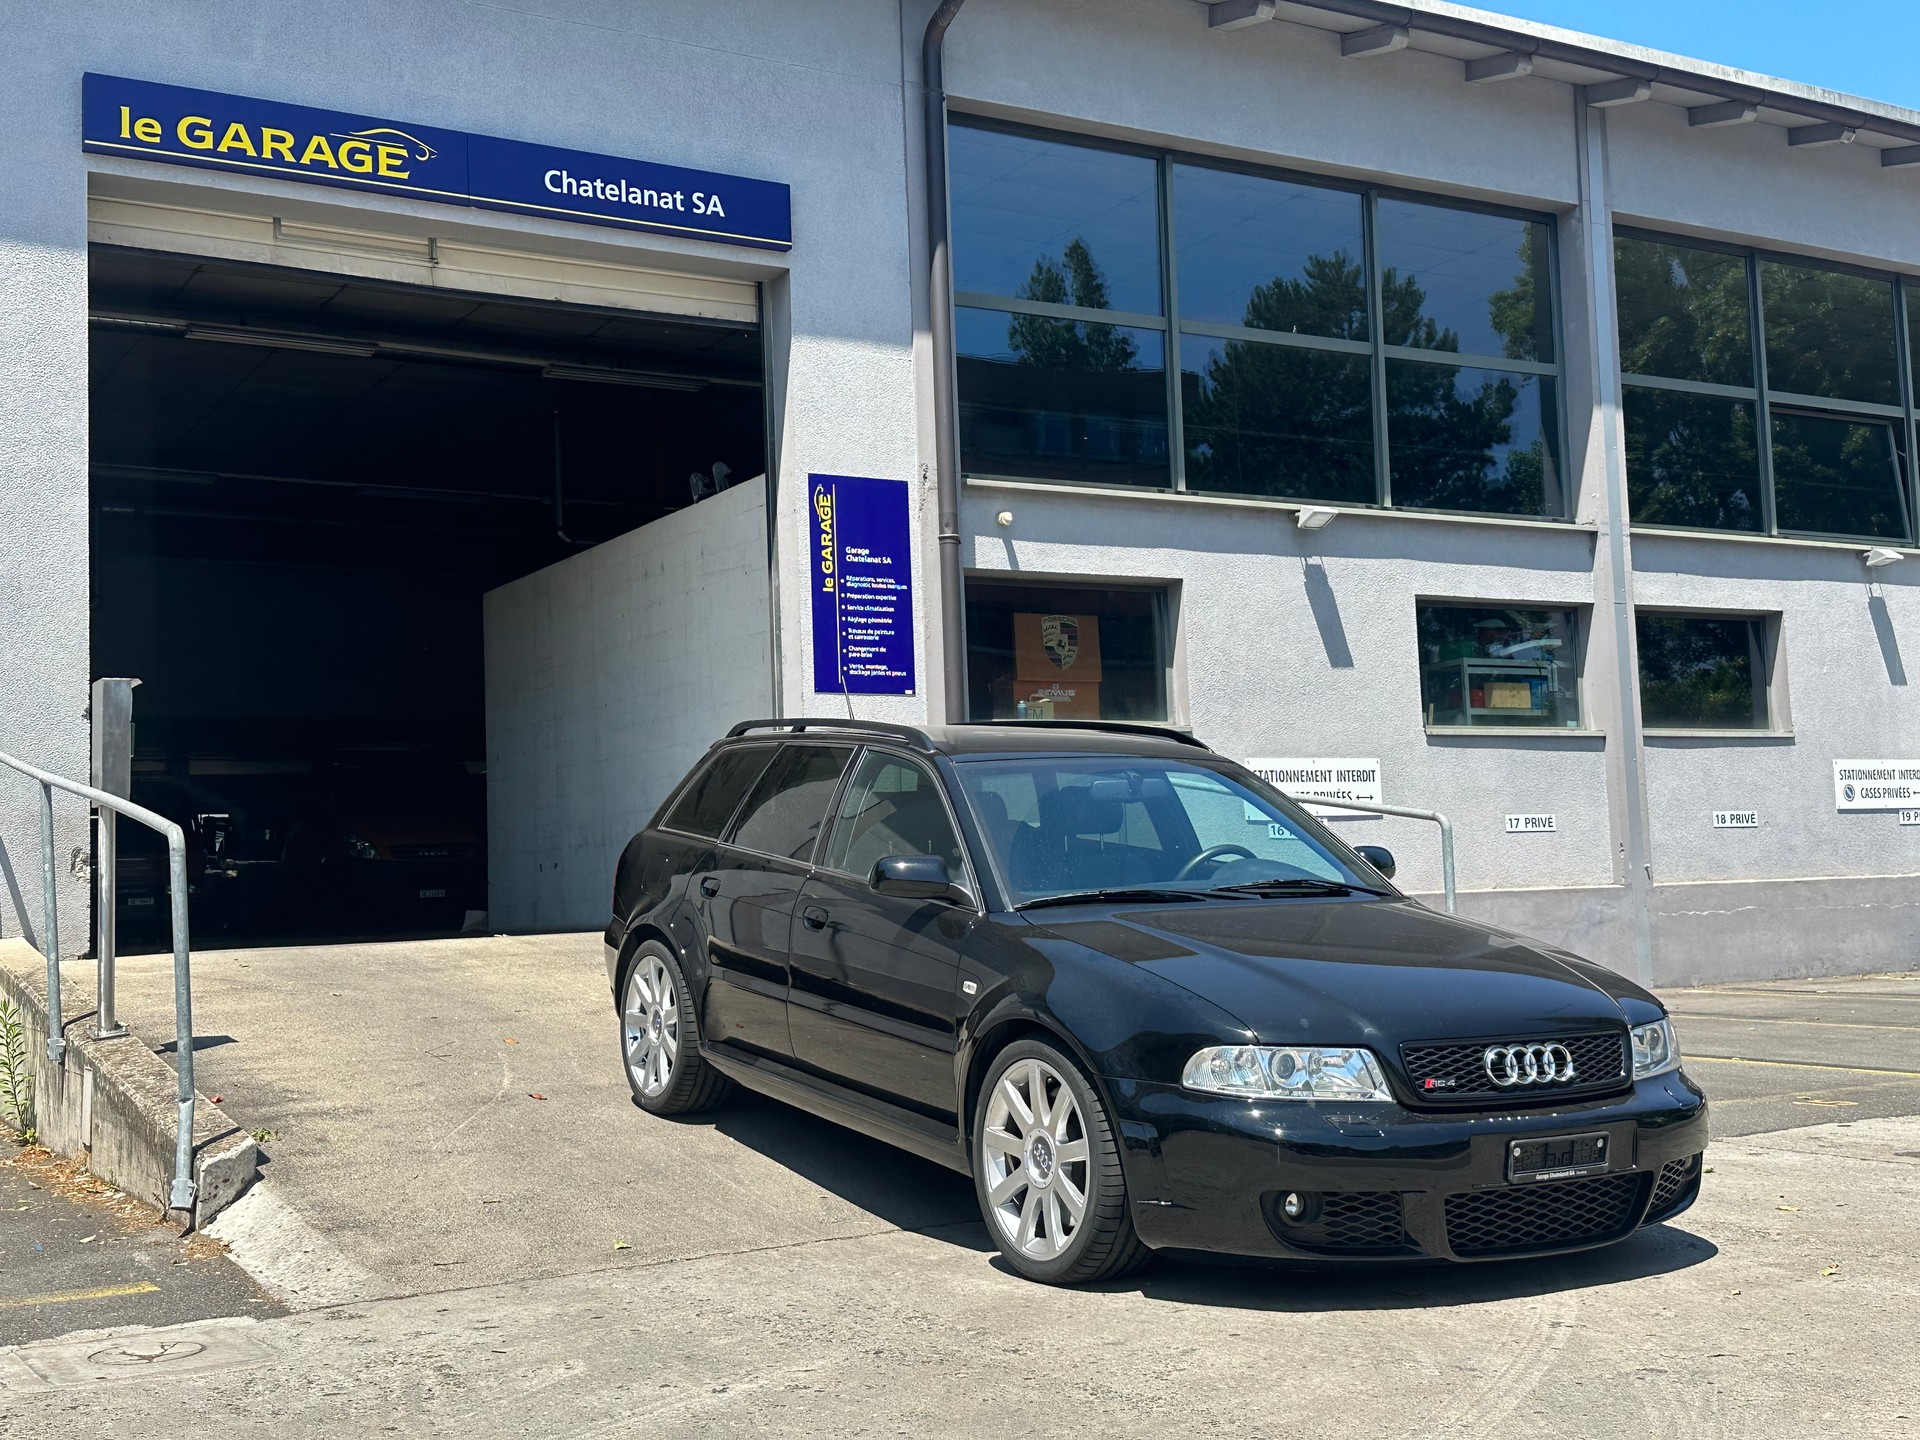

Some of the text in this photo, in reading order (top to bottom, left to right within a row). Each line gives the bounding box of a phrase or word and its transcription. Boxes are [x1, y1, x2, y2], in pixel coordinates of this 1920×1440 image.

[119, 105, 410, 180] le GARAGE
[544, 170, 725, 218] Chatelanat SA
[819, 494, 834, 592] le GARAGE
[846, 546, 870, 556] Garage
[846, 555, 892, 564] Chatelanat SA
[1252, 770, 1376, 783] TATIONNEMENT INTERDIT
[1839, 769, 1895, 780] STATIONNEMENT
[1861, 785, 1910, 798] CASES PRIVÉES
[1508, 815, 1554, 828] 17 PRIVÉ
[1715, 811, 1756, 824] 18 PRIVÉ
[1902, 811, 1910, 821] 19
[1271, 825, 1284, 836] 16
